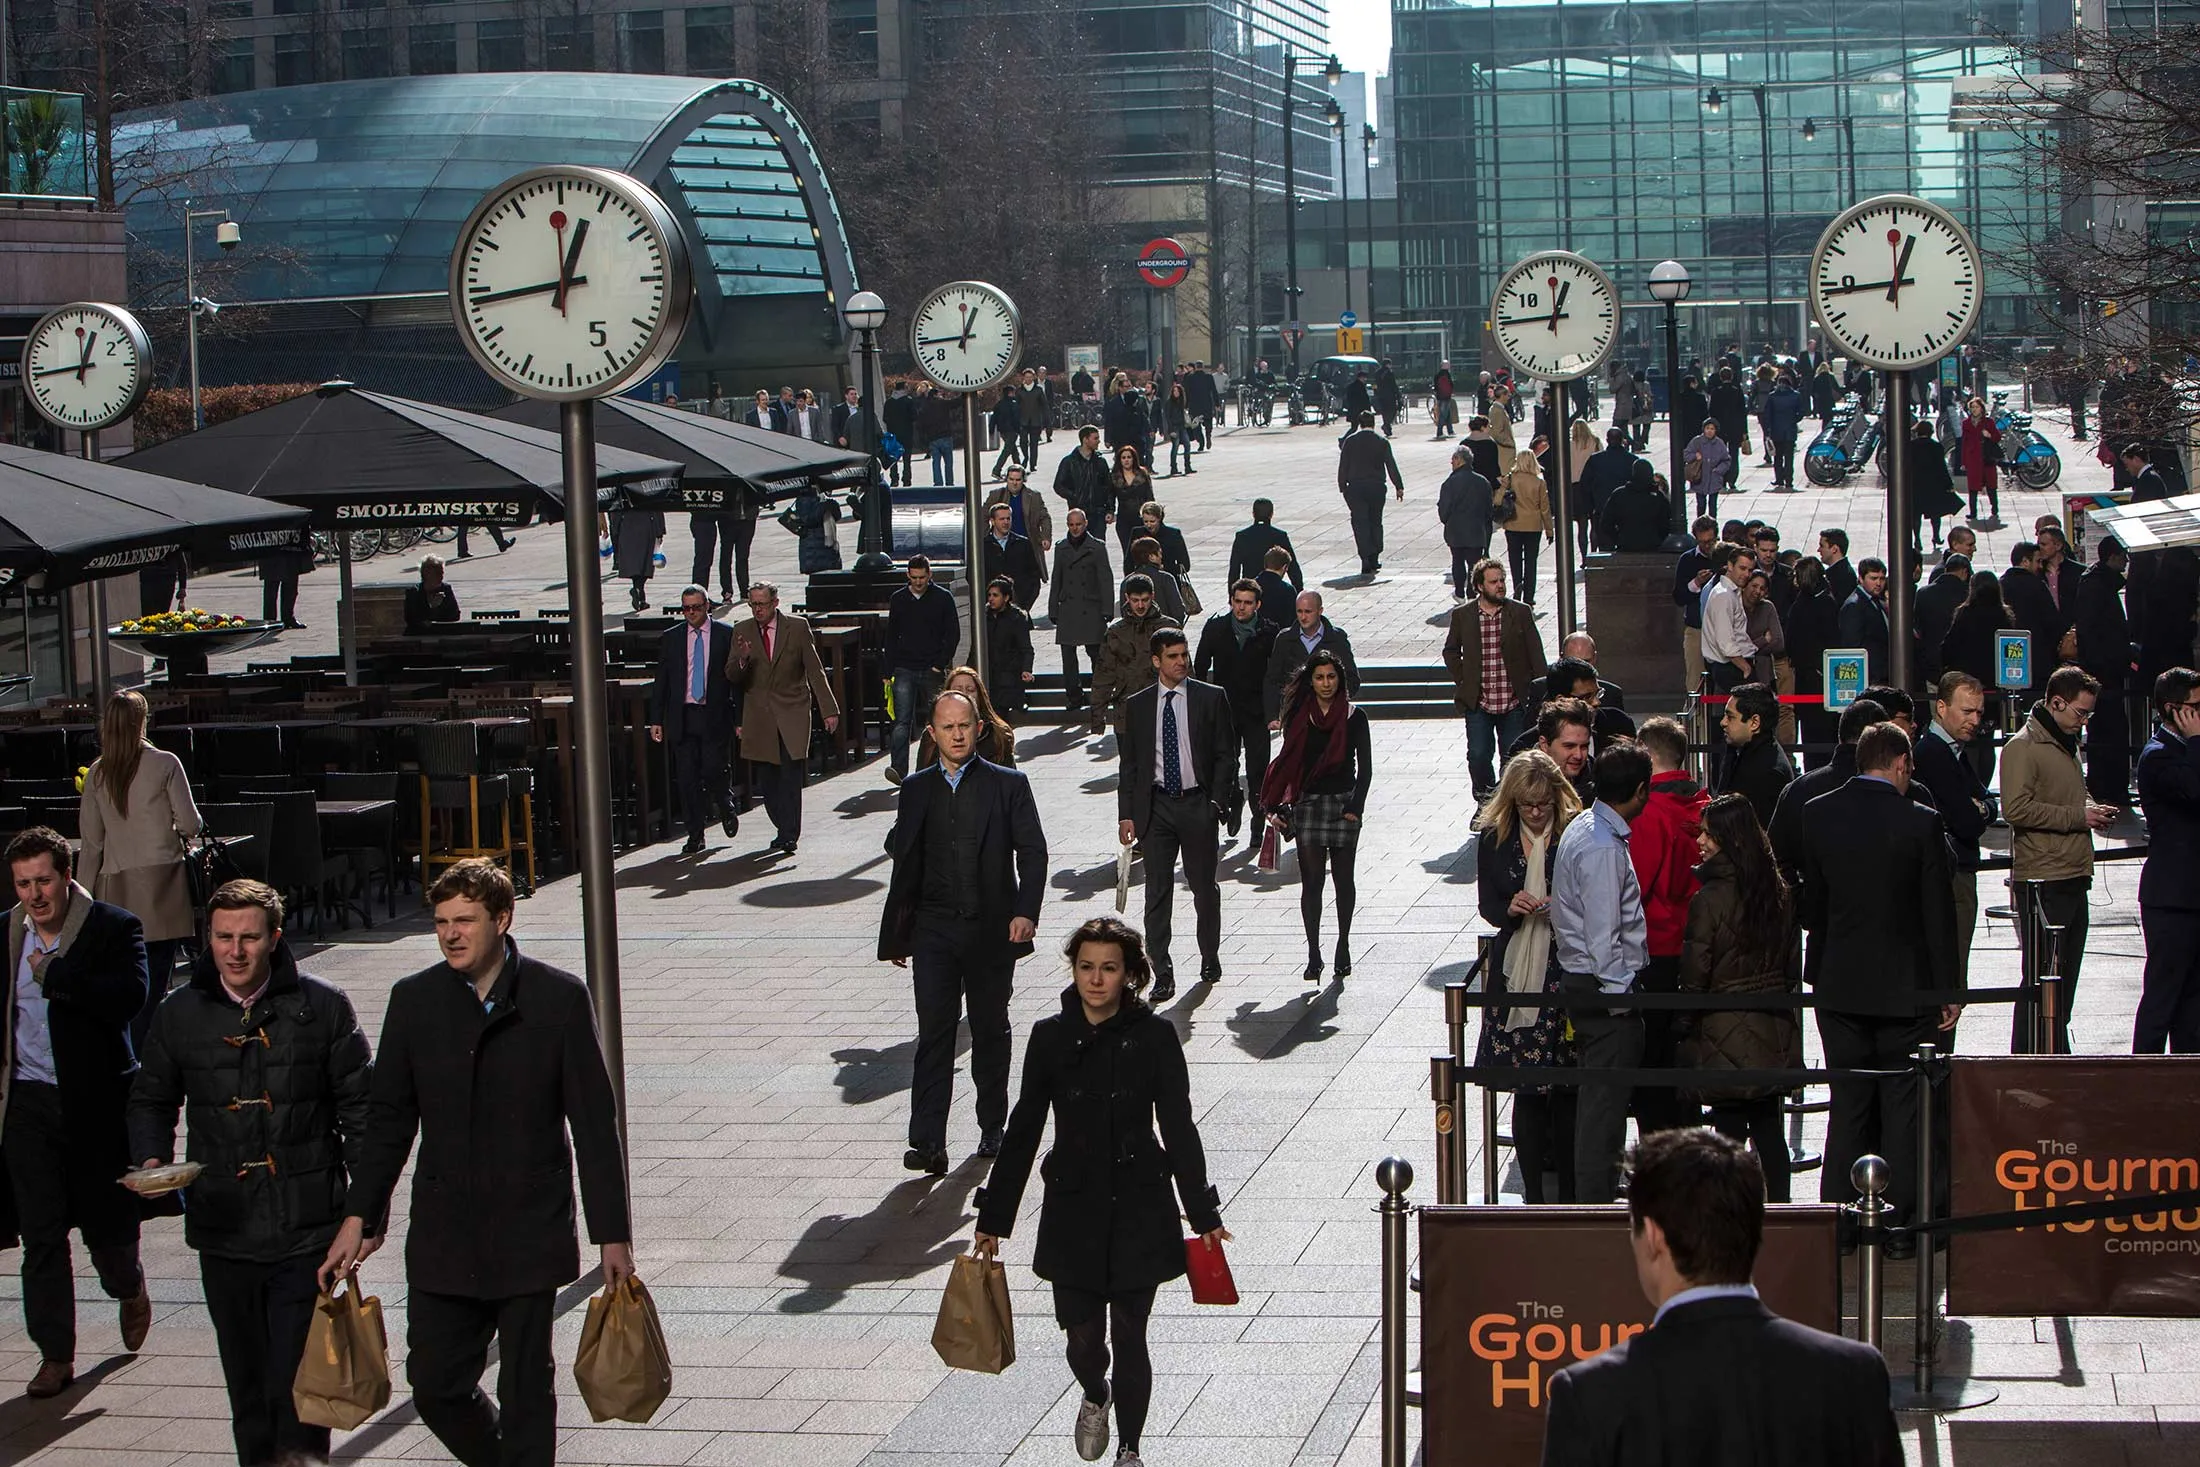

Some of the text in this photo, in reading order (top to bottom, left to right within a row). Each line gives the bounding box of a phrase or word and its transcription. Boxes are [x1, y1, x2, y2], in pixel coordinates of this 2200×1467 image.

[1137, 259, 1188, 267] UNDERGROUND
[1519, 293, 1538, 308] 10
[589, 321, 606, 347] 5
[106, 341, 117, 356] 2
[937, 348, 946, 361] 8
[336, 502, 520, 519] SMOLLENSKY'S
[2037, 1139, 2078, 1155] The
[1995, 1150, 2199, 1192] Gourm
[2104, 1238, 2200, 1255] Company
[1517, 1301, 1565, 1319] The
[1469, 1313, 1656, 1361] Gour
[1492, 1360, 1551, 1408] H
